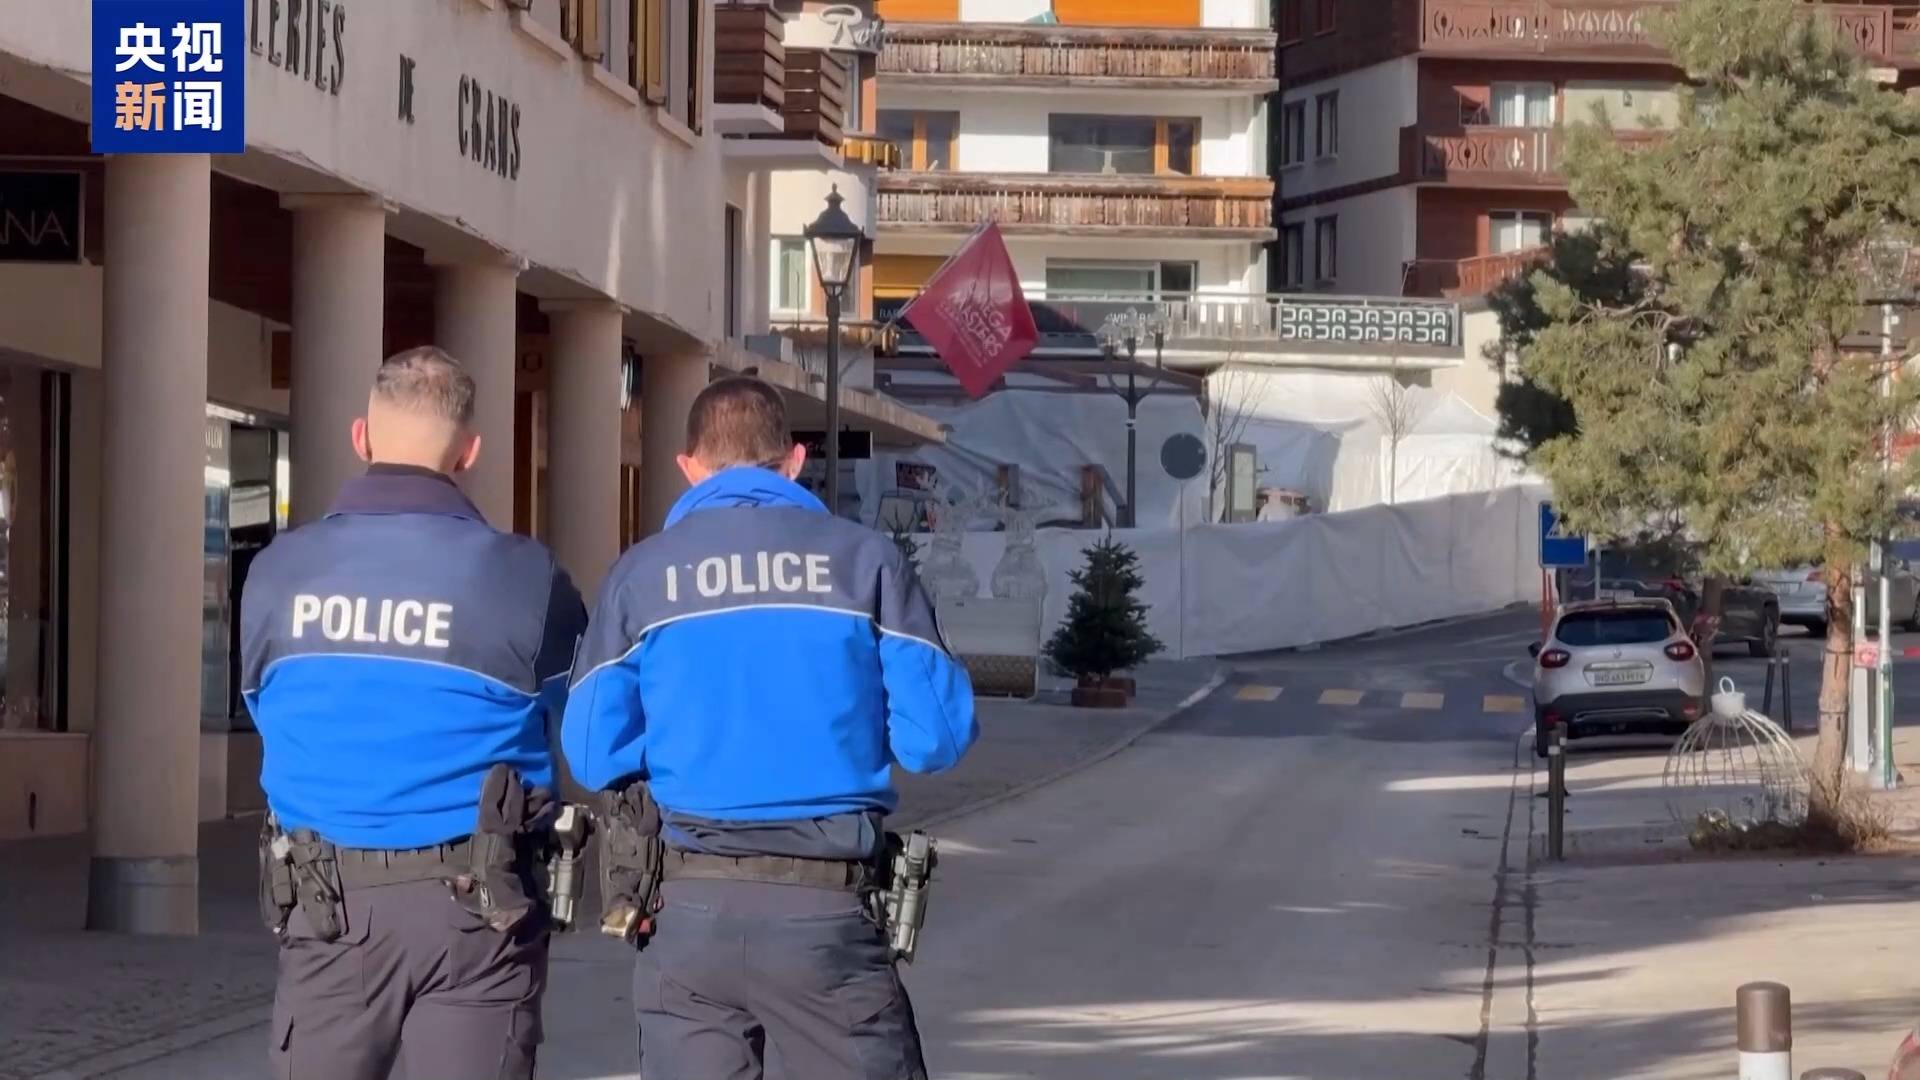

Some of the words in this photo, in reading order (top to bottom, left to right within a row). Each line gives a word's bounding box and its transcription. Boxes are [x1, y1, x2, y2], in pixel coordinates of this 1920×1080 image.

[458, 74, 521, 181] CRANS
[0, 209, 70, 247] NA
[292, 594, 453, 648] POLICE
